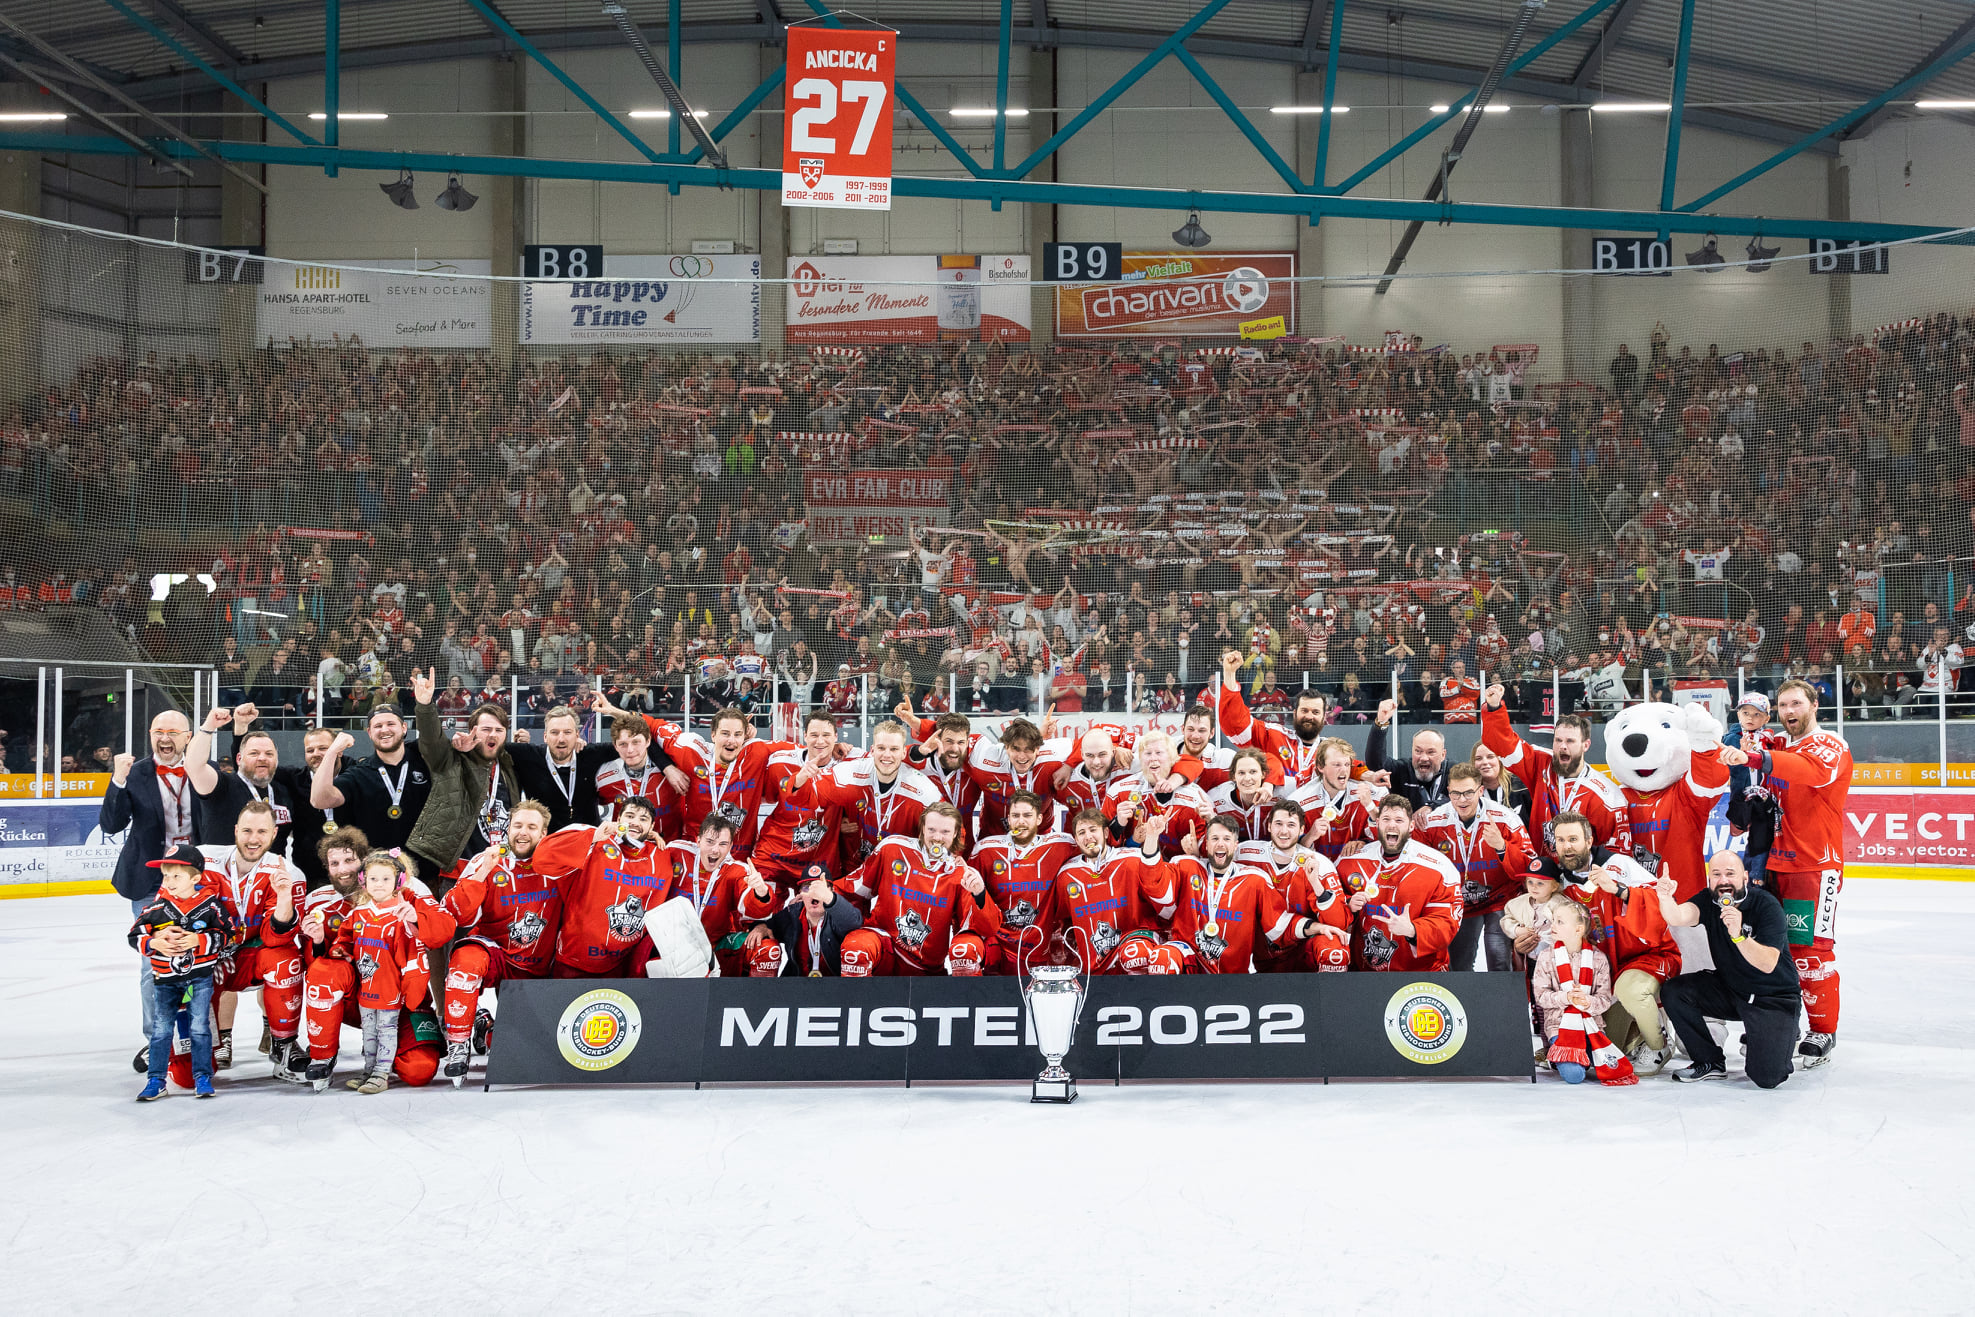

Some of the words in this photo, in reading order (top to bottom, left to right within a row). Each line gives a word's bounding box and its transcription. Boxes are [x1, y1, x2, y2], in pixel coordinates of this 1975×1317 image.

[878, 40, 886, 52] C
[806, 50, 877, 72] ANCICKA
[791, 78, 887, 155] 27
[786, 190, 834, 201] 2002-2006
[846, 181, 888, 191] 1997-1999
[845, 193, 862, 202] 2011
[200, 250, 221, 281] B
[230, 250, 249, 281] 7
[539, 248, 560, 278] B
[568, 248, 588, 278] 8
[1057, 245, 1079, 278] B
[1087, 245, 1107, 278] 9
[1597, 242, 1617, 271] B
[1628, 242, 1668, 271] 10
[1816, 241, 1838, 271] B
[1146, 261, 1193, 278] Vielfalt
[264, 293, 300, 303] HANSA
[302, 293, 371, 303] APART-HOTEL
[387, 286, 427, 295] SEVEN
[433, 286, 486, 295] OCEANS
[570, 281, 668, 303] Happy
[1093, 284, 1217, 318] charivari
[289, 306, 345, 315] REGENSBURG
[571, 304, 647, 326] Time
[797, 298, 860, 318] besondere
[865, 292, 929, 311] Momente
[396, 320, 437, 336] Seafood
[440, 320, 447, 329] &
[451, 318, 476, 331] More
[1243, 322, 1267, 334] Radio
[1268, 319, 1281, 330] an!
[1846, 812, 1975, 841] VECT
[1857, 843, 1975, 858] jobs.vector.
[603, 868, 666, 891] STEMMLE
[997, 879, 1053, 893] STEMMLE
[254, 889, 263, 905] C
[500, 887, 558, 906] STEMMLE
[891, 884, 948, 909] STEMMLE
[1074, 896, 1129, 918] STEMMLE
[1820, 875, 1837, 933] VECTOR
[580, 1003, 623, 1019] DEUTSCHER
[1403, 997, 1446, 1012] DEUTSCHER
[720, 1006, 1038, 1047] MEISTE
[1096, 1004, 1305, 1046] 2022
[1400, 1024, 1452, 1049] EISHOCKEY-BUND
[573, 1030, 625, 1056] EISHOCKEY-BUND
